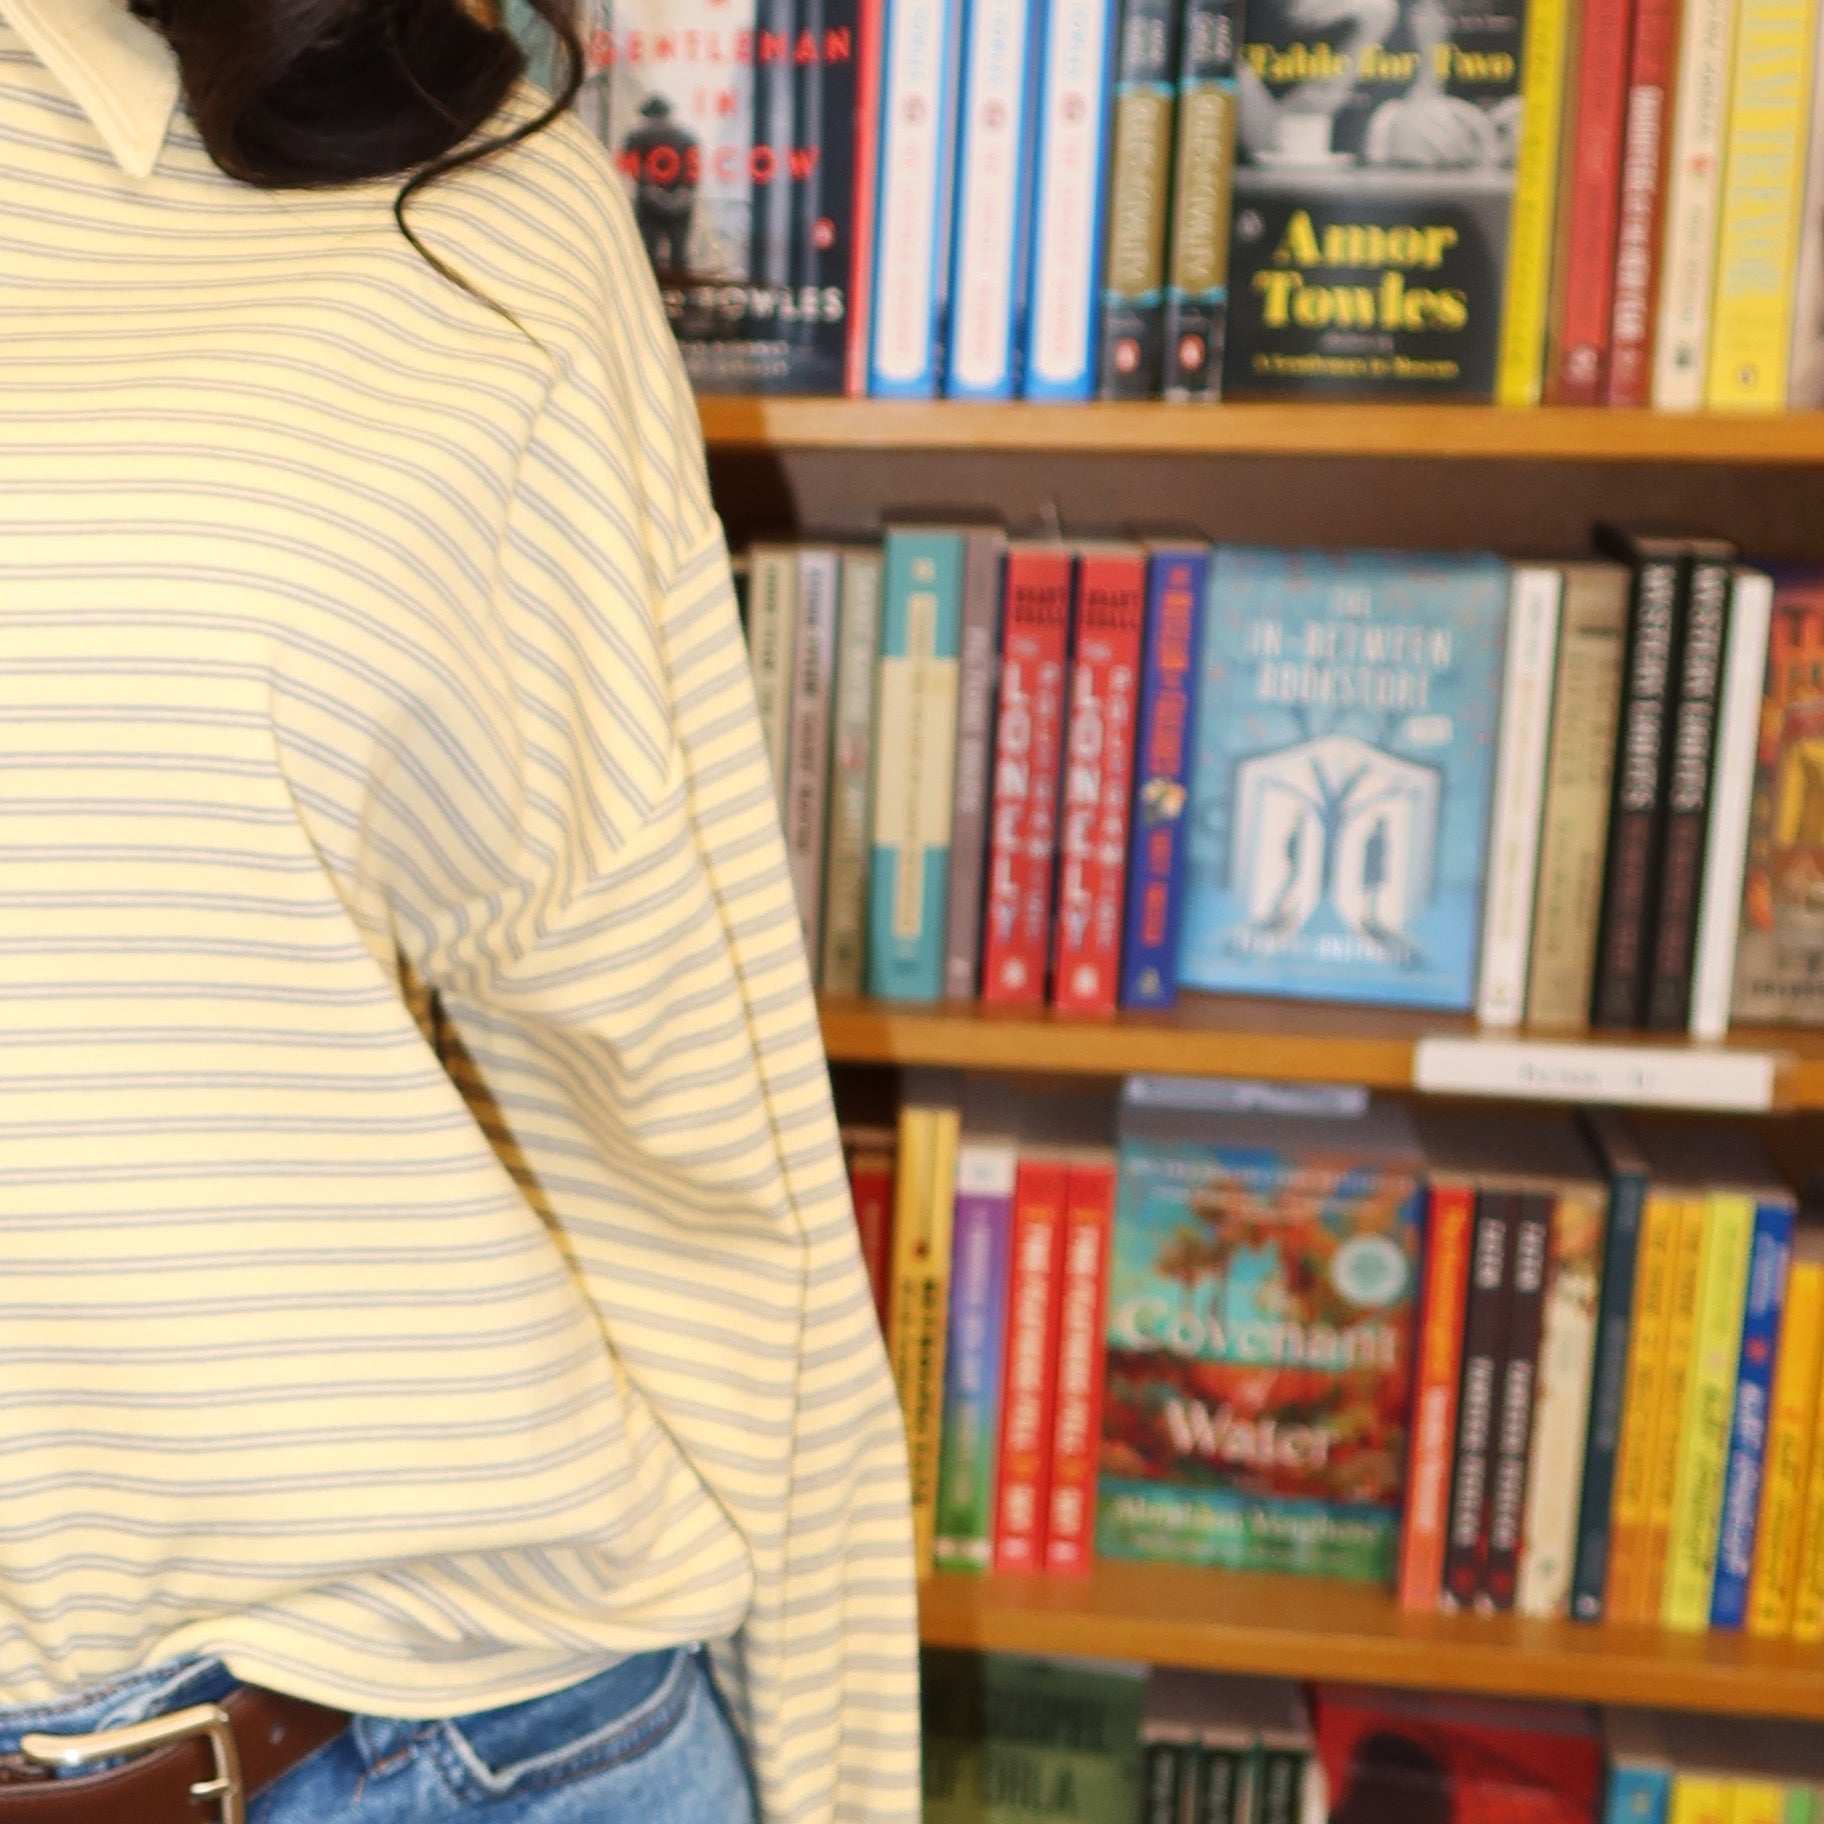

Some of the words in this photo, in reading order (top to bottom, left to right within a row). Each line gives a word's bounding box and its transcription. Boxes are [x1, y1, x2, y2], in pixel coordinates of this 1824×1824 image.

[591, 26, 852, 68] GENTLEMAN
[1241, 40, 1349, 80] Table
[1359, 43, 1419, 80] for
[1432, 42, 1516, 80] Two
[694, 87, 736, 117] IN
[616, 144, 820, 184] MOSCOW
[1276, 209, 1458, 270] Amor
[697, 285, 845, 322] TOWLES
[1252, 268, 1469, 332] Towles
[993, 661, 1033, 944] LONELY
[1064, 667, 1104, 950] LONELY
[1118, 1294, 1400, 1371] Covenant
[1164, 1398, 1335, 1470] Water
